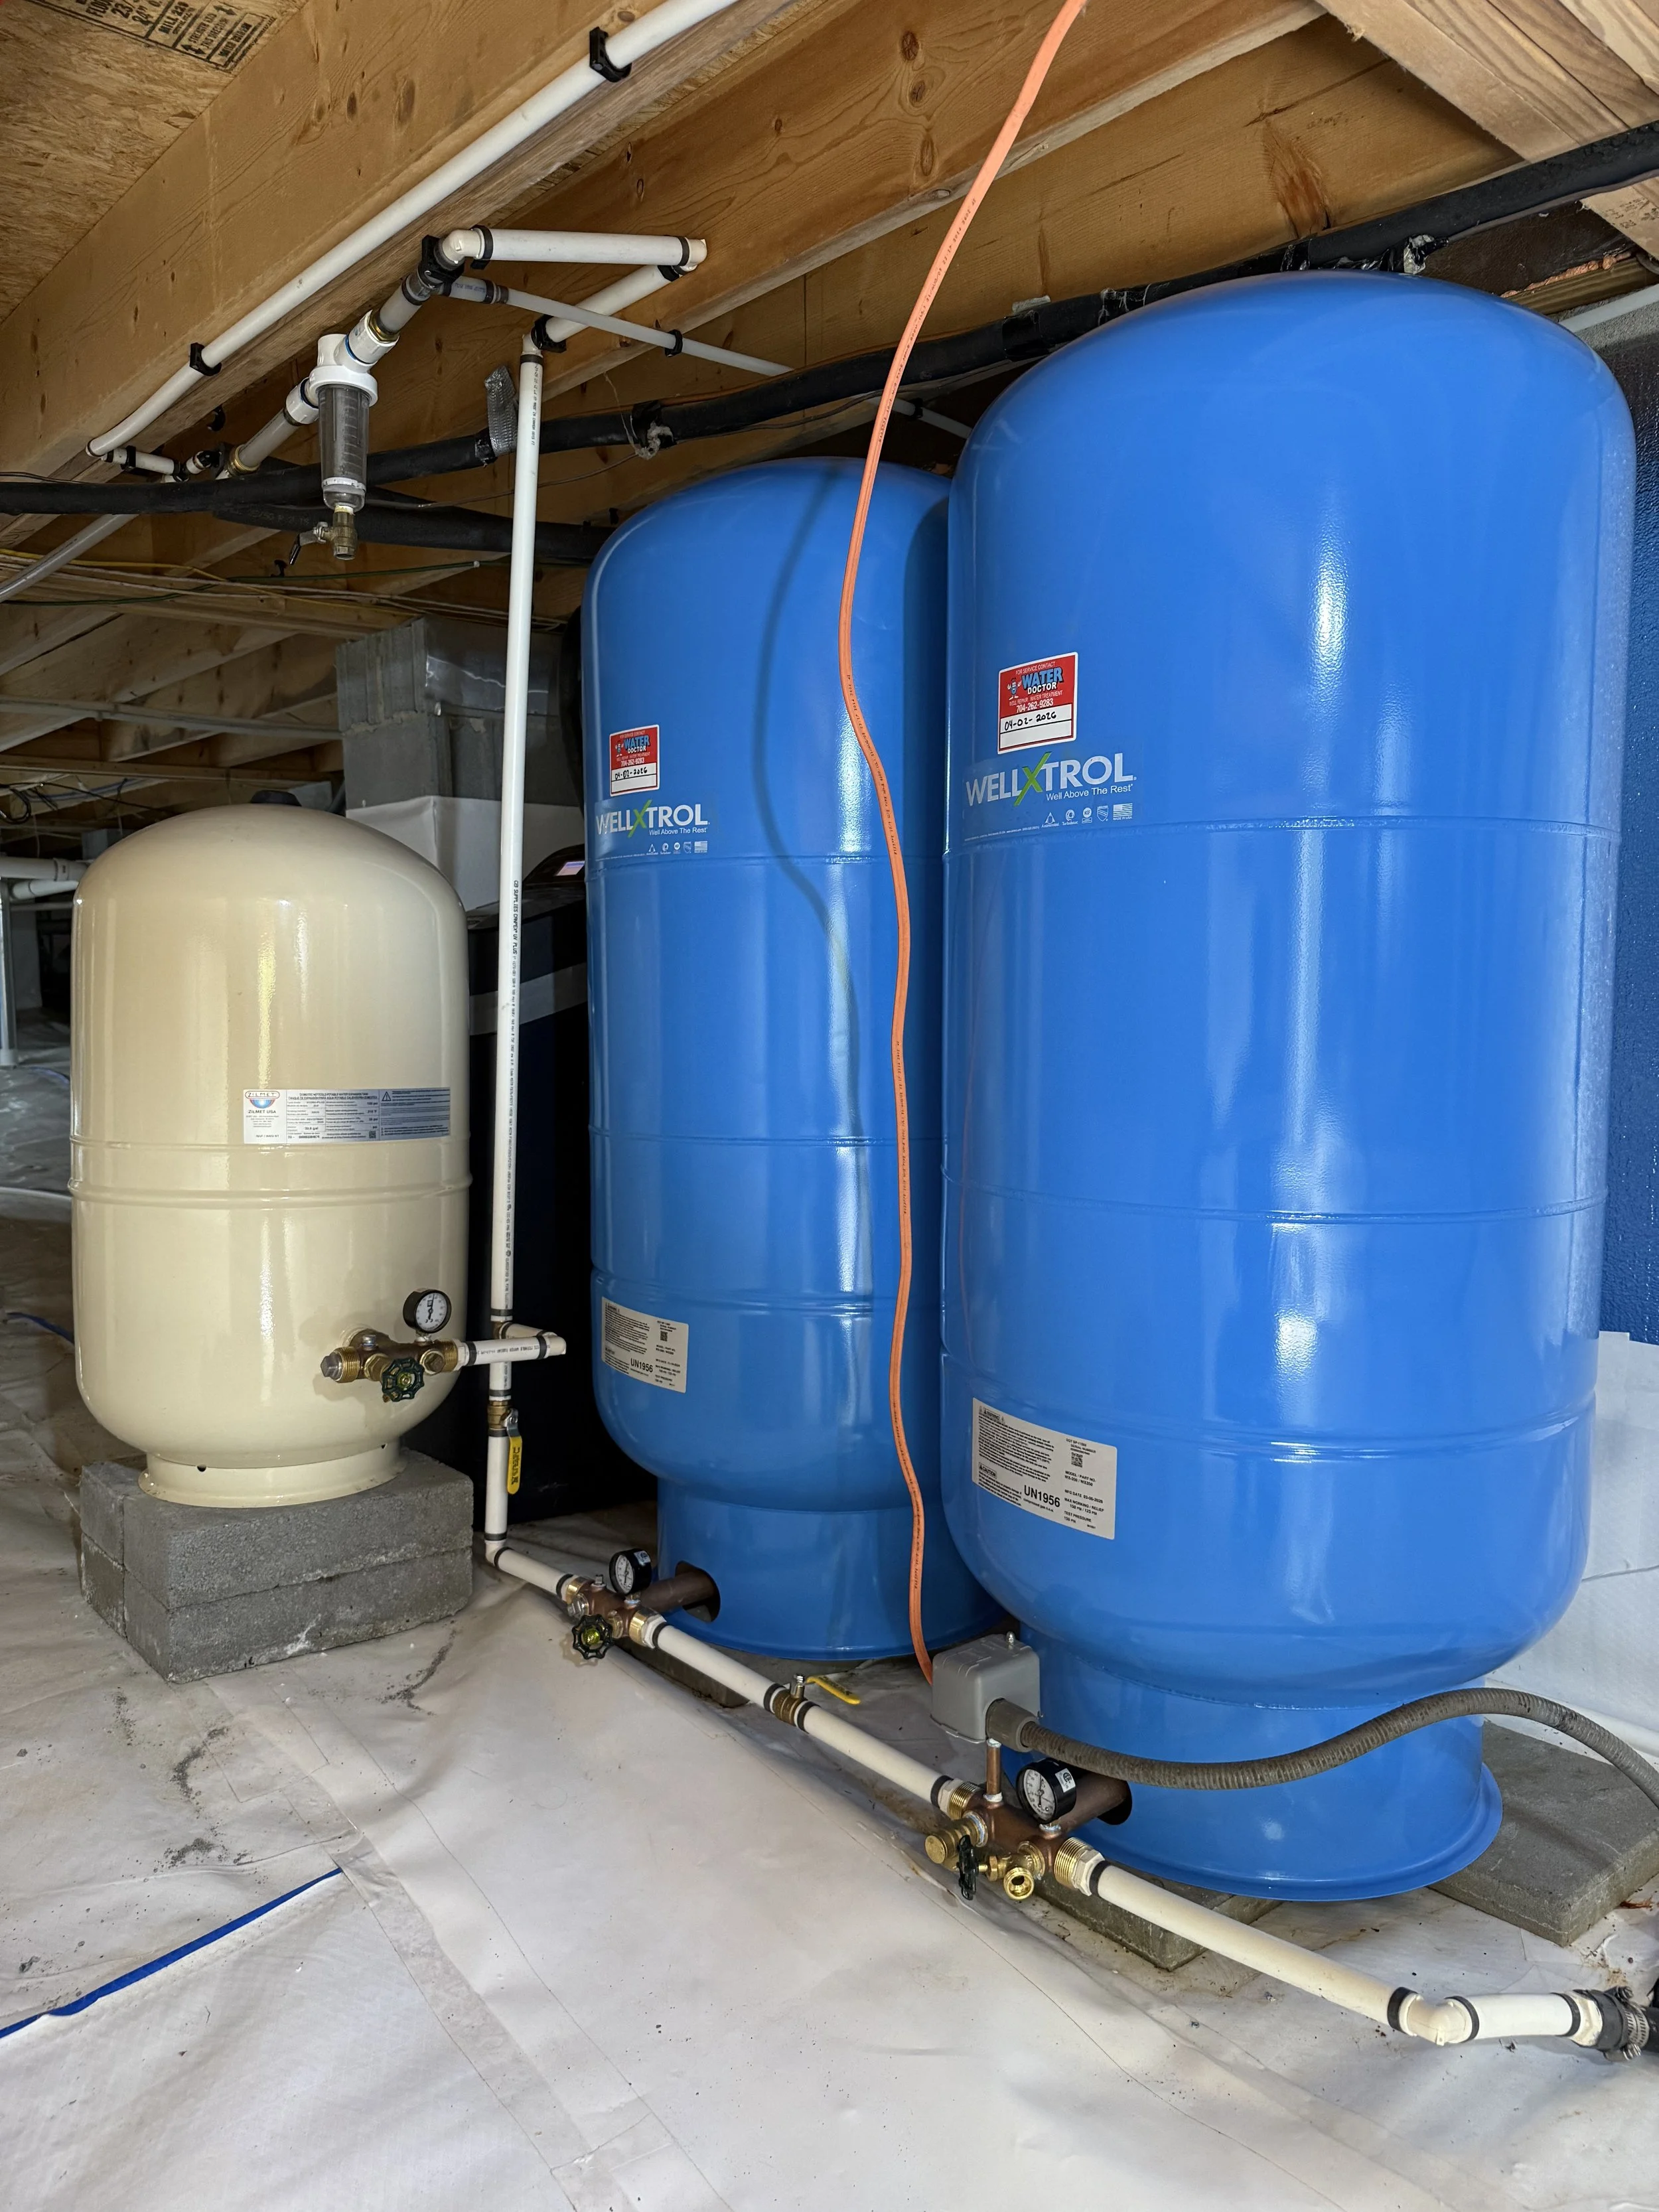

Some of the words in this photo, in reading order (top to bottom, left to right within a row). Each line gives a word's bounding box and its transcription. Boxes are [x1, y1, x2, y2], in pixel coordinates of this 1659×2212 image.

[1038, 662, 1056, 670] CONTACT
[1021, 667, 1064, 690] WATER
[1027, 682, 1057, 695] DOCTOR
[1042, 690, 1063, 700] TREATMENT
[1016, 698, 1053, 713] 704-262-9283
[624, 735, 650, 749] WATER
[627, 745, 646, 754] DOCTOR
[1046, 790, 1062, 800] Well
[1064, 789, 1089, 798] Above
[1092, 786, 1108, 796] The
[630, 1358, 653, 1373] UN1956
[1024, 1485, 1060, 1508] UN1956
